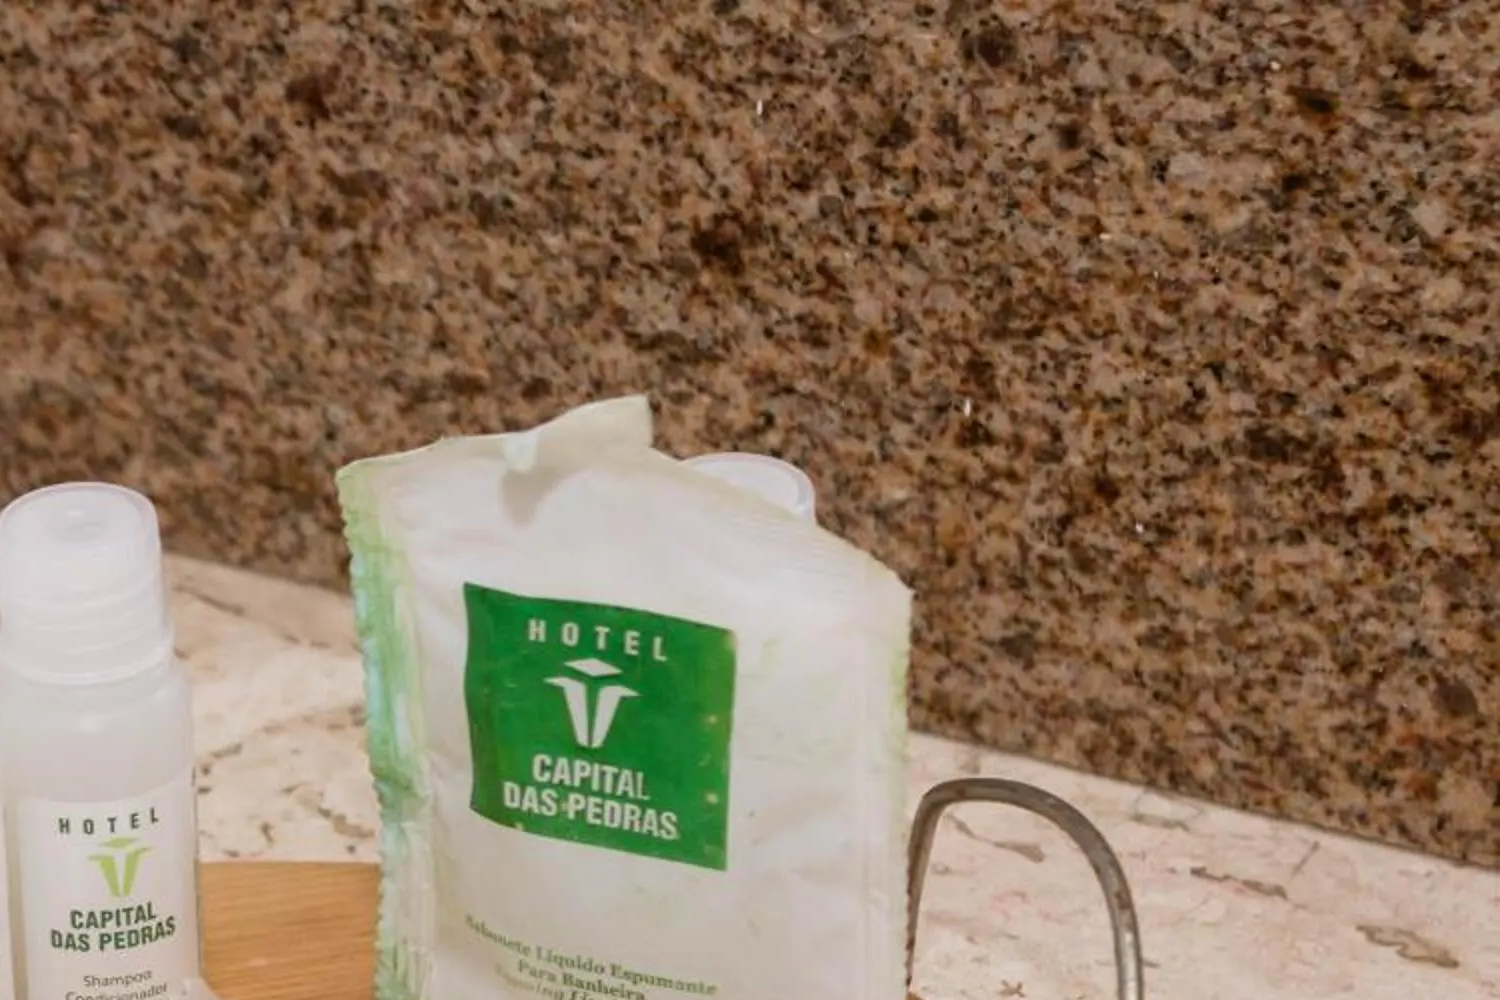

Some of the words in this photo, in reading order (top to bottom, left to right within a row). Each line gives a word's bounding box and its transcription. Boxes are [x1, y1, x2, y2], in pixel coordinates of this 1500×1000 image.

[529, 619, 668, 662] HOTEL
[532, 753, 651, 800] CAPITAL
[58, 807, 159, 835] HOTEL
[503, 781, 558, 817] DAS
[567, 793, 679, 840] PEDRAS
[50, 929, 90, 952] DAS
[99, 916, 176, 950] PEDRAS
[70, 901, 157, 929] CAPITAL
